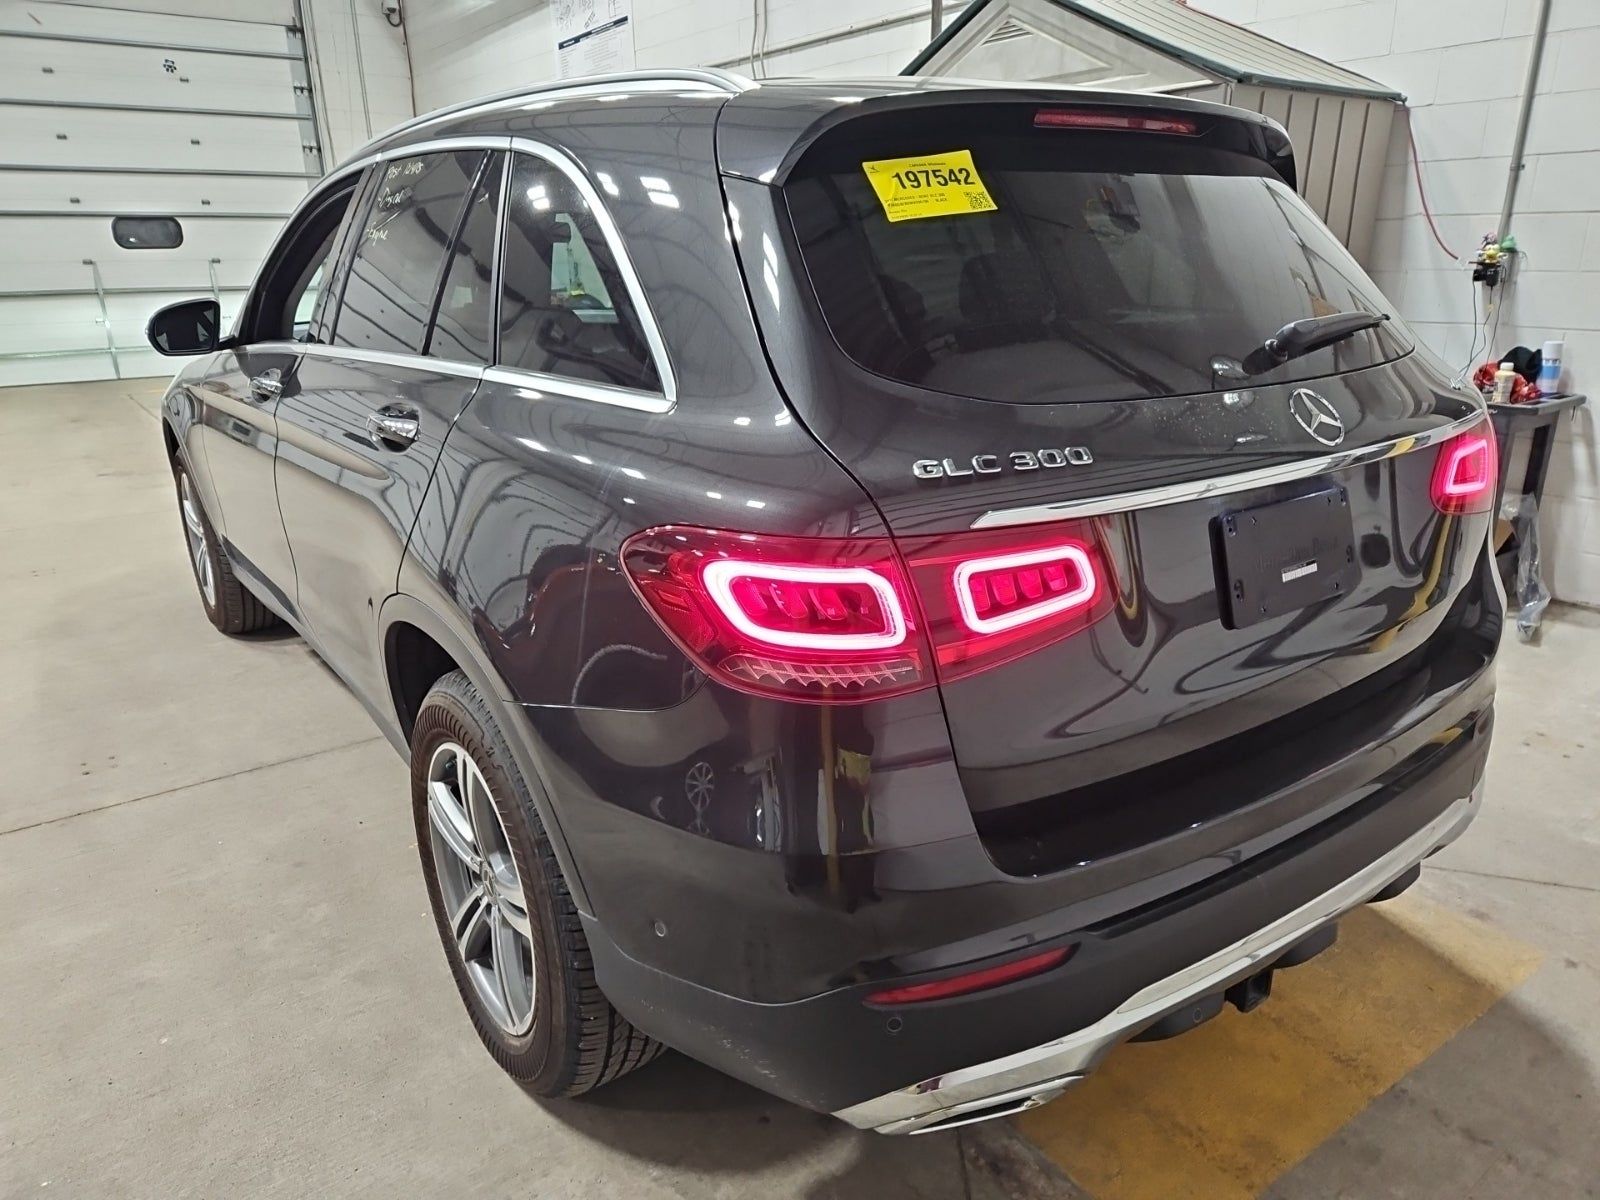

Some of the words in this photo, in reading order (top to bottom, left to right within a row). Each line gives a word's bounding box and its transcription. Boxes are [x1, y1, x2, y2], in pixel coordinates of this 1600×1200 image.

[892, 168, 975, 189] 197542
[912, 454, 1001, 479] GLC
[1009, 446, 1093, 471] 300
